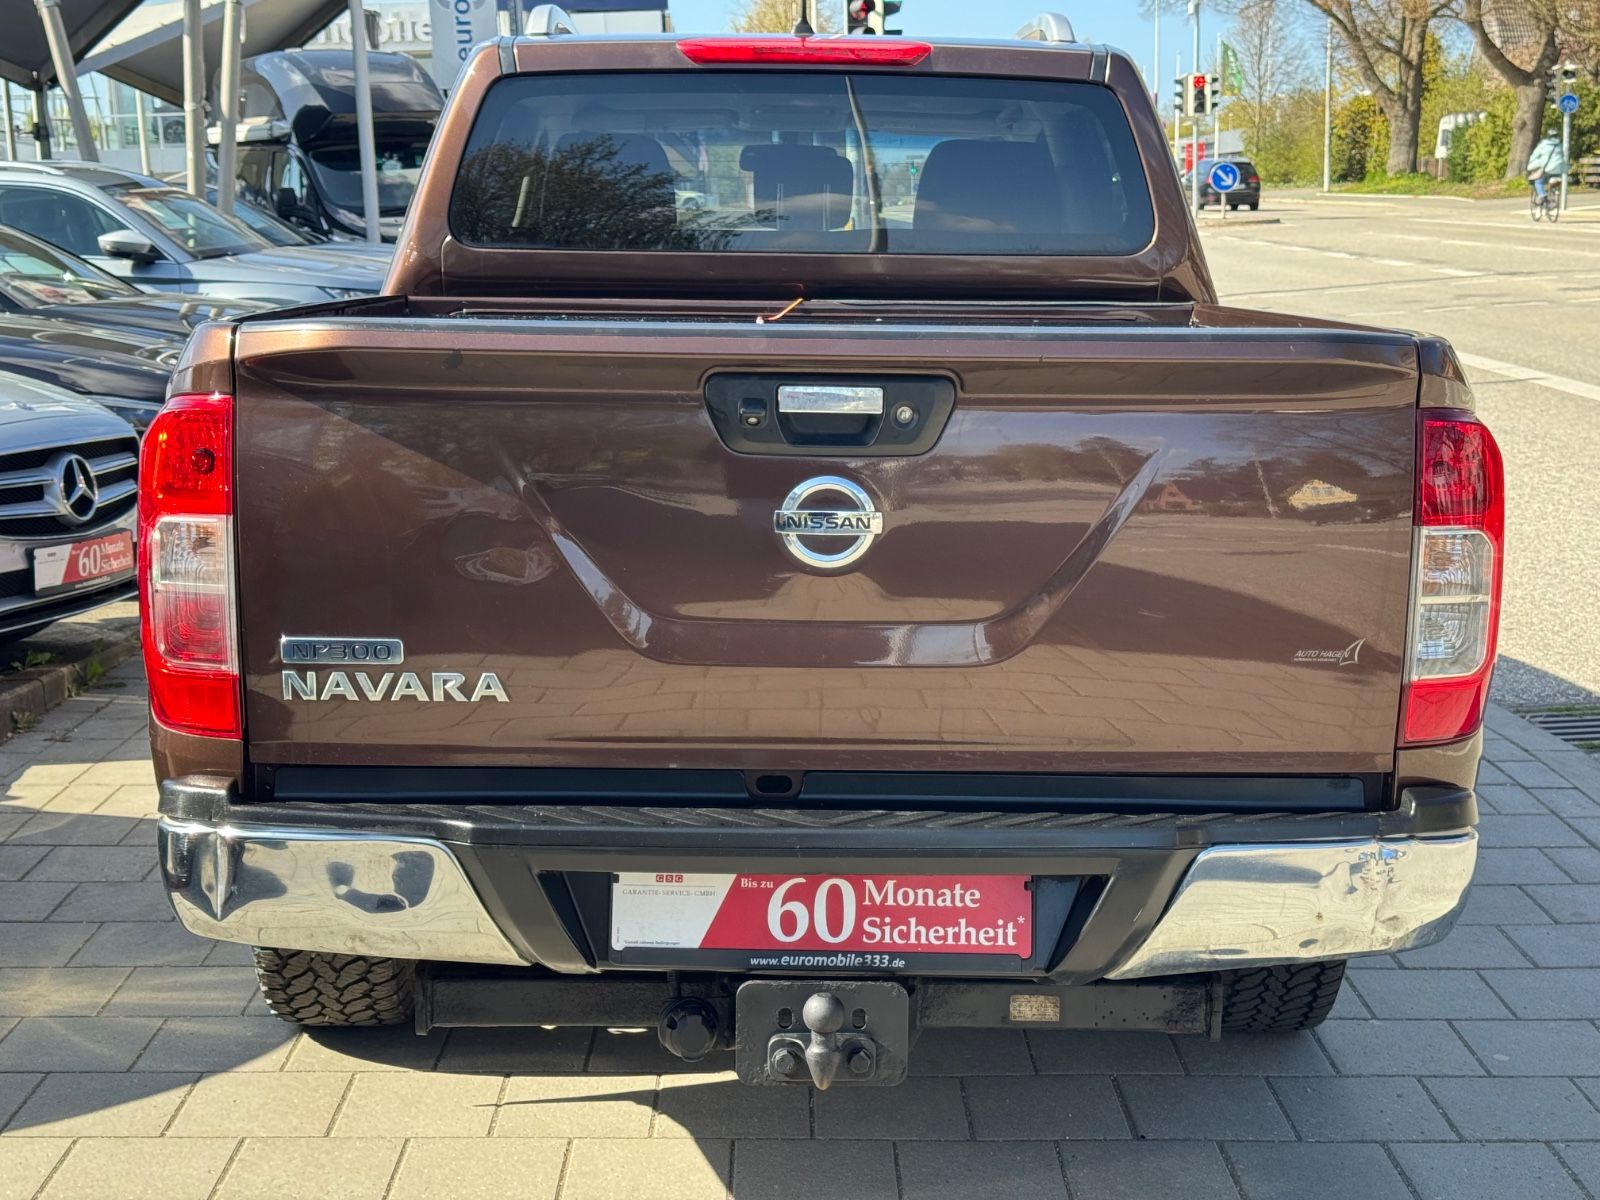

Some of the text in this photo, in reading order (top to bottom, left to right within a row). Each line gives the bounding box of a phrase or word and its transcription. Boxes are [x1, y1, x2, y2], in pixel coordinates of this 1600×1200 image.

[786, 515, 871, 530] NISSAN
[79, 544, 101, 576] 60
[291, 642, 394, 661] NP300
[1294, 649, 1319, 658] AUTO
[281, 670, 510, 702] NAVARA
[740, 878, 774, 889] Bis zu
[862, 879, 982, 908] Monate
[767, 876, 857, 944] 60
[749, 952, 906, 969] www.euromobile333.de
